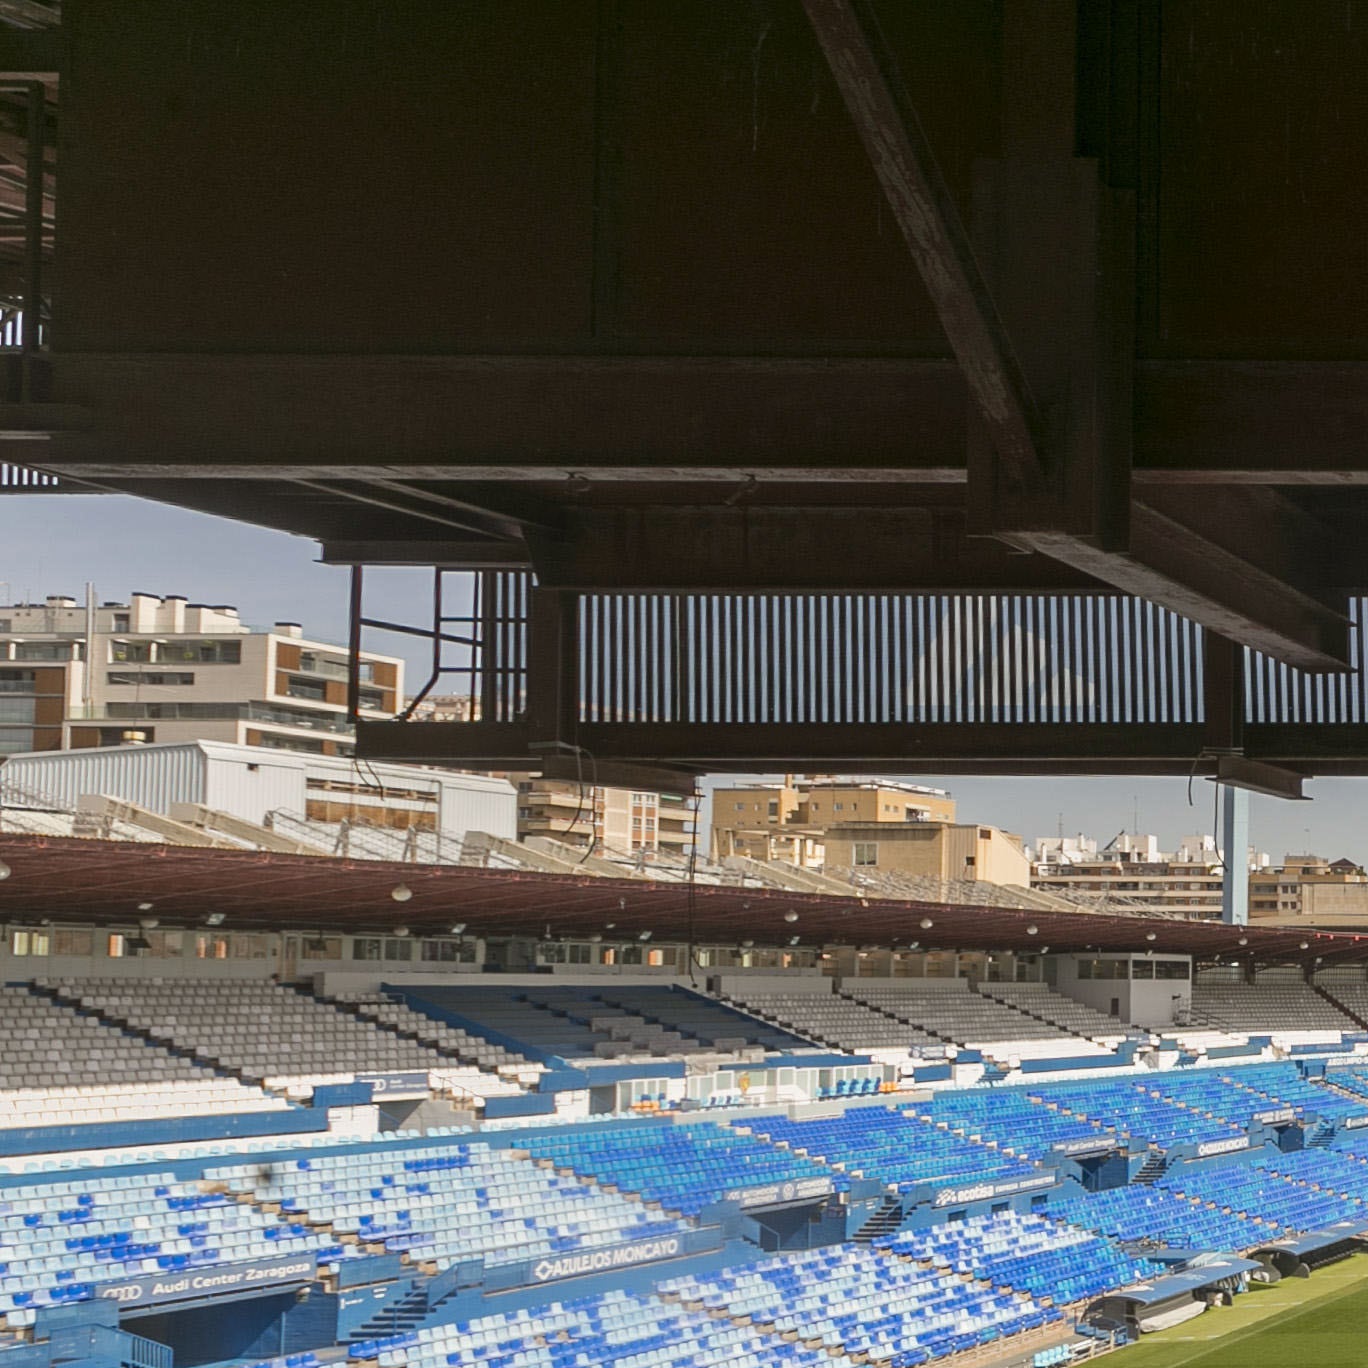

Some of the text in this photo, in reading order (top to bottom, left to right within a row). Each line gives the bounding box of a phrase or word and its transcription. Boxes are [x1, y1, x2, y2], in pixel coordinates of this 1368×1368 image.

[551, 1239, 678, 1277] AZULEJOS MONCAYO
[153, 1260, 311, 1296] Audi Center Zaragoza
